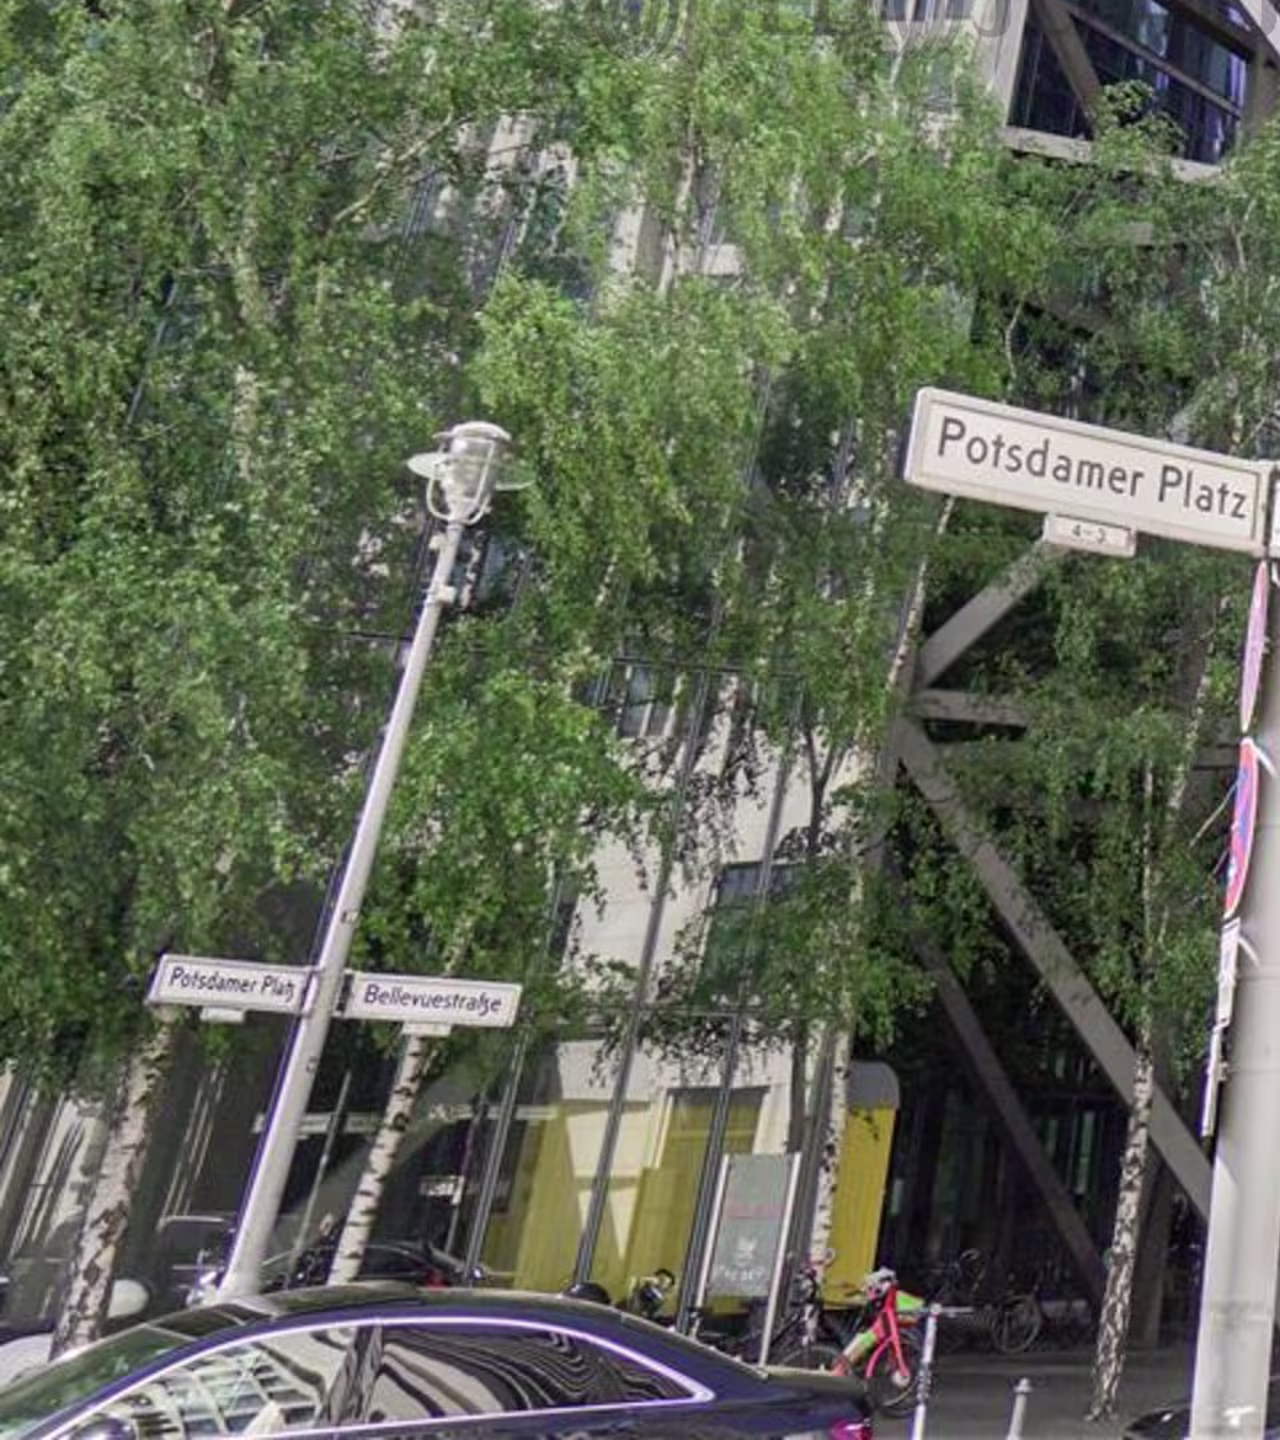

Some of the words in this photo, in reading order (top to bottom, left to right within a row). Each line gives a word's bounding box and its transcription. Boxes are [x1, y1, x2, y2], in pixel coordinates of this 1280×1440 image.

[936, 415, 1143, 497] Potsdamer
[1158, 464, 1248, 520] Platz
[168, 966, 256, 994] Potsdamer
[260, 974, 296, 1002] Platz
[363, 984, 502, 1017] Bellevuestraße
